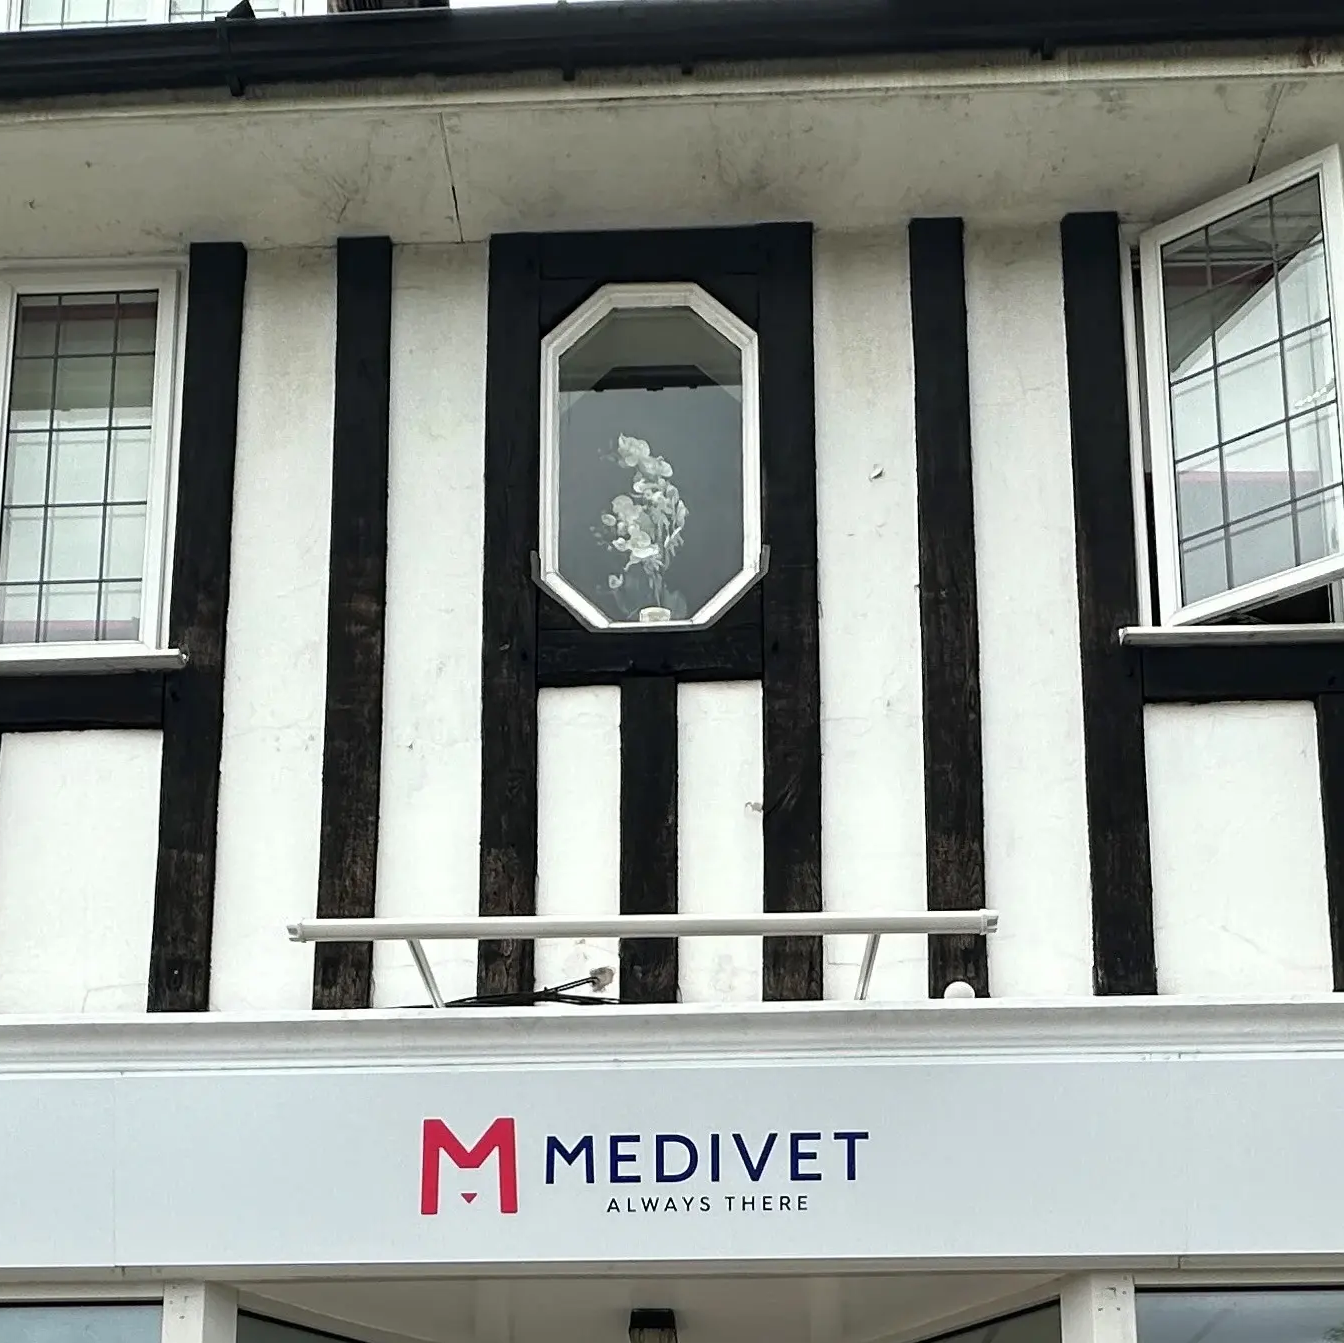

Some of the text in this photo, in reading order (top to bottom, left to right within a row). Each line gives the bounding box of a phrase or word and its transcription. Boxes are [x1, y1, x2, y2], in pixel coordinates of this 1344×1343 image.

[545, 1131, 869, 1185] MEDIVET
[606, 1195, 808, 1213] ALWAYS THERE
